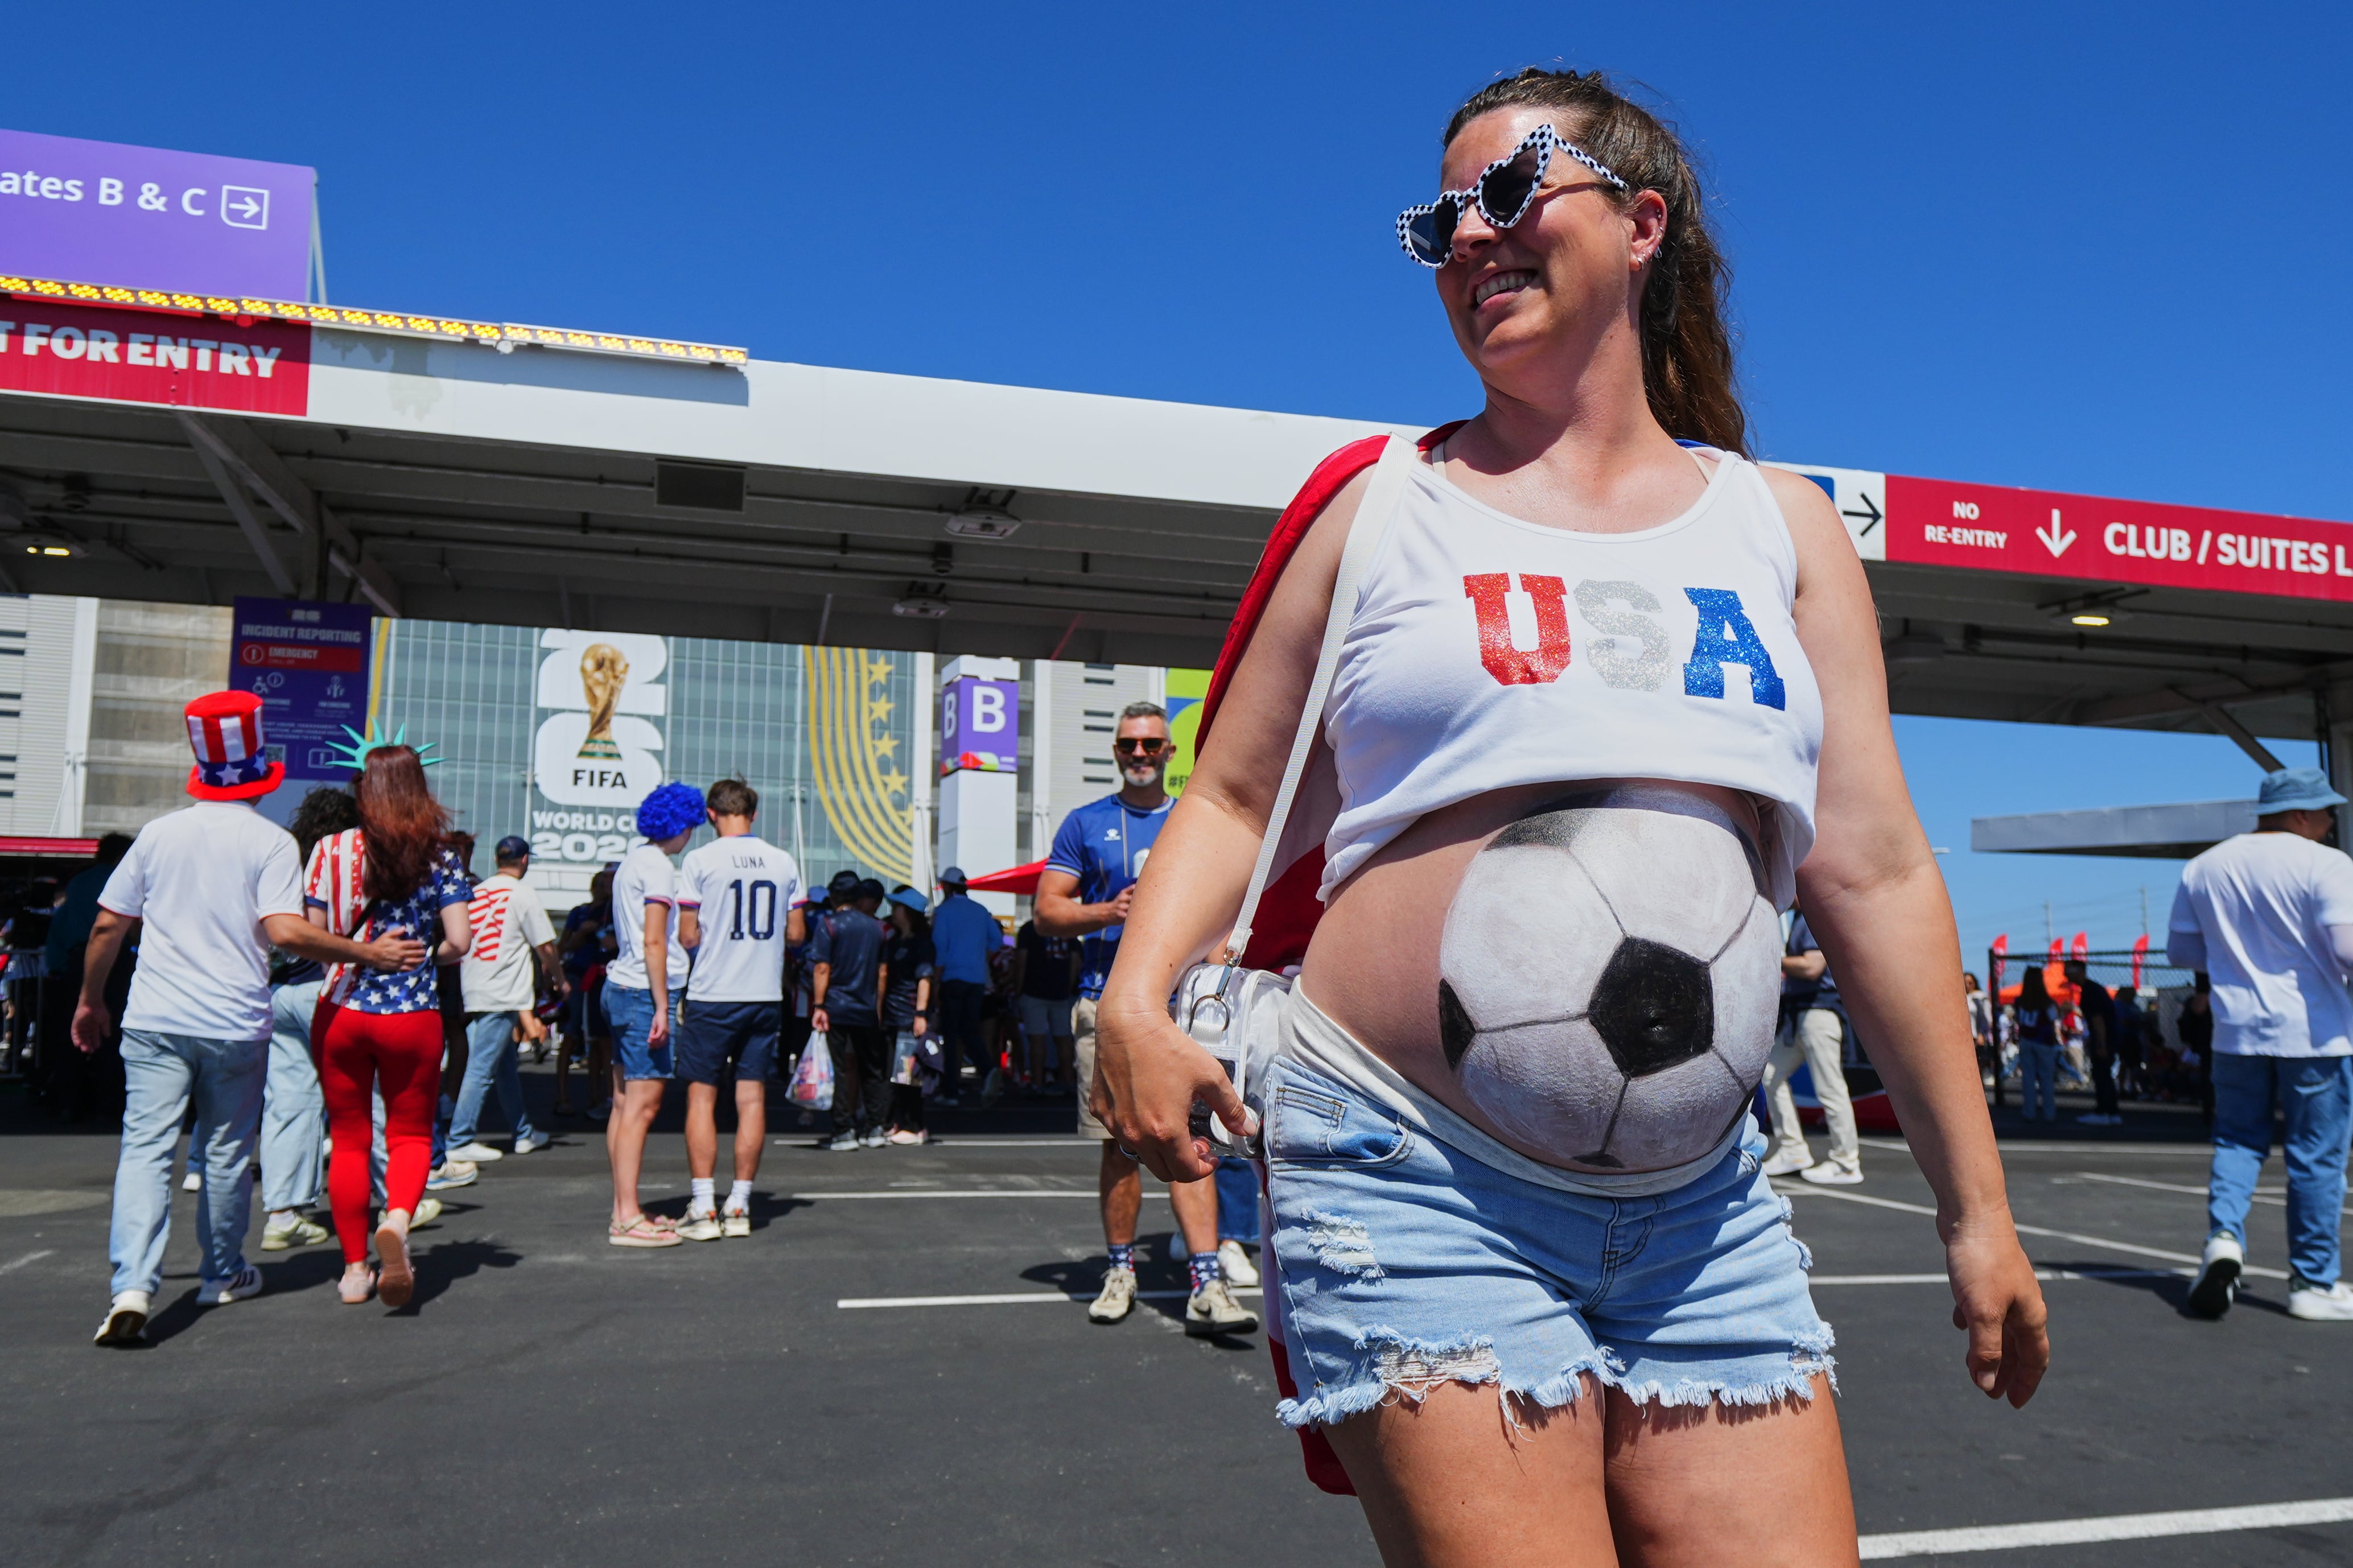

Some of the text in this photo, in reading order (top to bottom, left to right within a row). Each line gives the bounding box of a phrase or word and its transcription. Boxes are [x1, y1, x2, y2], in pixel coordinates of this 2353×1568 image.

[98, 177, 124, 206] B
[137, 182, 168, 212] &
[181, 188, 207, 216] C
[23, 323, 121, 364] FOR
[127, 333, 282, 378] ENTRY
[1952, 501, 1980, 520] NO
[1925, 524, 2008, 549] RE-ENTRY
[2103, 522, 2192, 562] CLUB
[2197, 530, 2212, 565] /
[2217, 533, 2330, 575] SUITES
[241, 624, 362, 643] INCIDENT REPORTING
[1462, 572, 1786, 711] USA
[269, 647, 318, 659] EMERGENCY
[943, 692, 958, 740] B
[972, 685, 1007, 733] B
[572, 769, 627, 789] FIFA
[533, 811, 615, 831] WORLD
[731, 855, 766, 869] LUNA
[730, 879, 777, 940] 10
